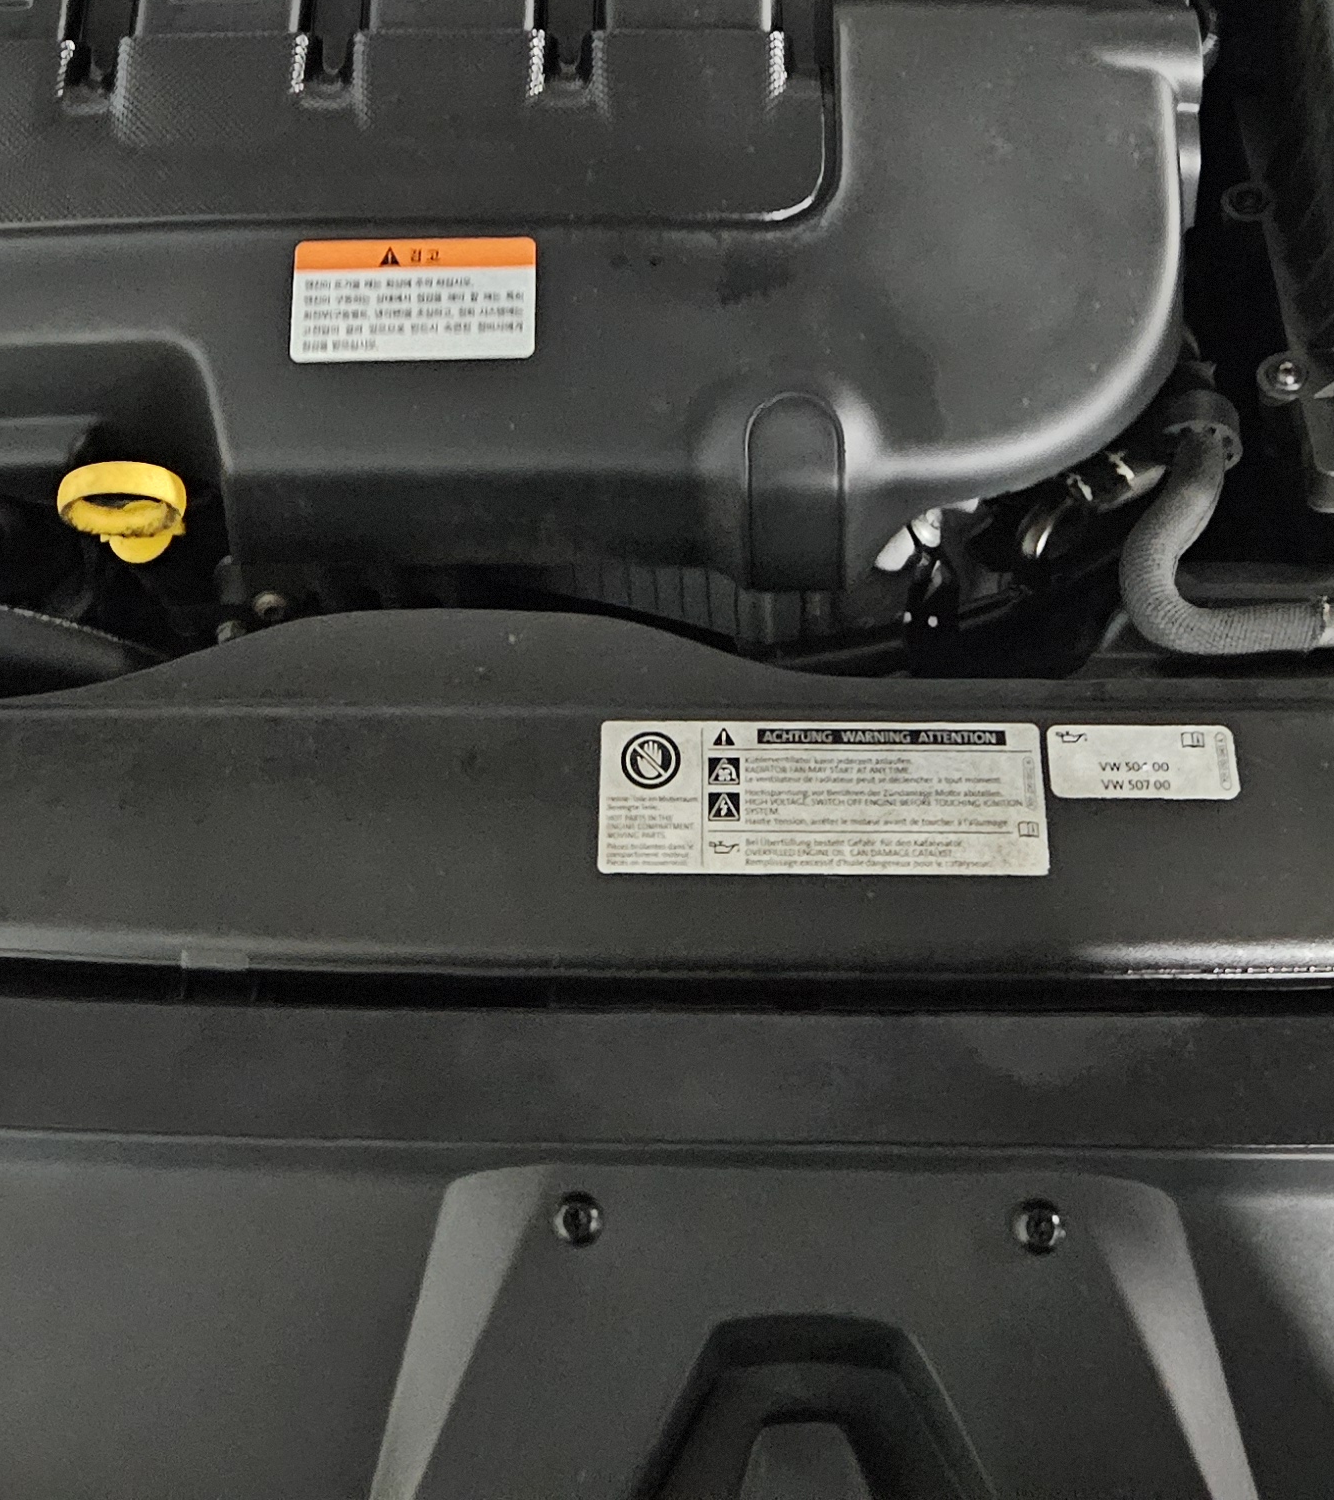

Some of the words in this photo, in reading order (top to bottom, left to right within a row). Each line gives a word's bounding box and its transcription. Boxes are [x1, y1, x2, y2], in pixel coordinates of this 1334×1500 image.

[763, 730, 833, 742] ACHTUNG
[841, 731, 911, 743] WARNING
[918, 732, 997, 744] ATTENTION
[1099, 762, 1121, 772] VW
[1152, 762, 1170, 772] 00
[1101, 780, 1124, 790] VW
[1128, 780, 1150, 790] 507
[1154, 780, 1171, 790] 00
